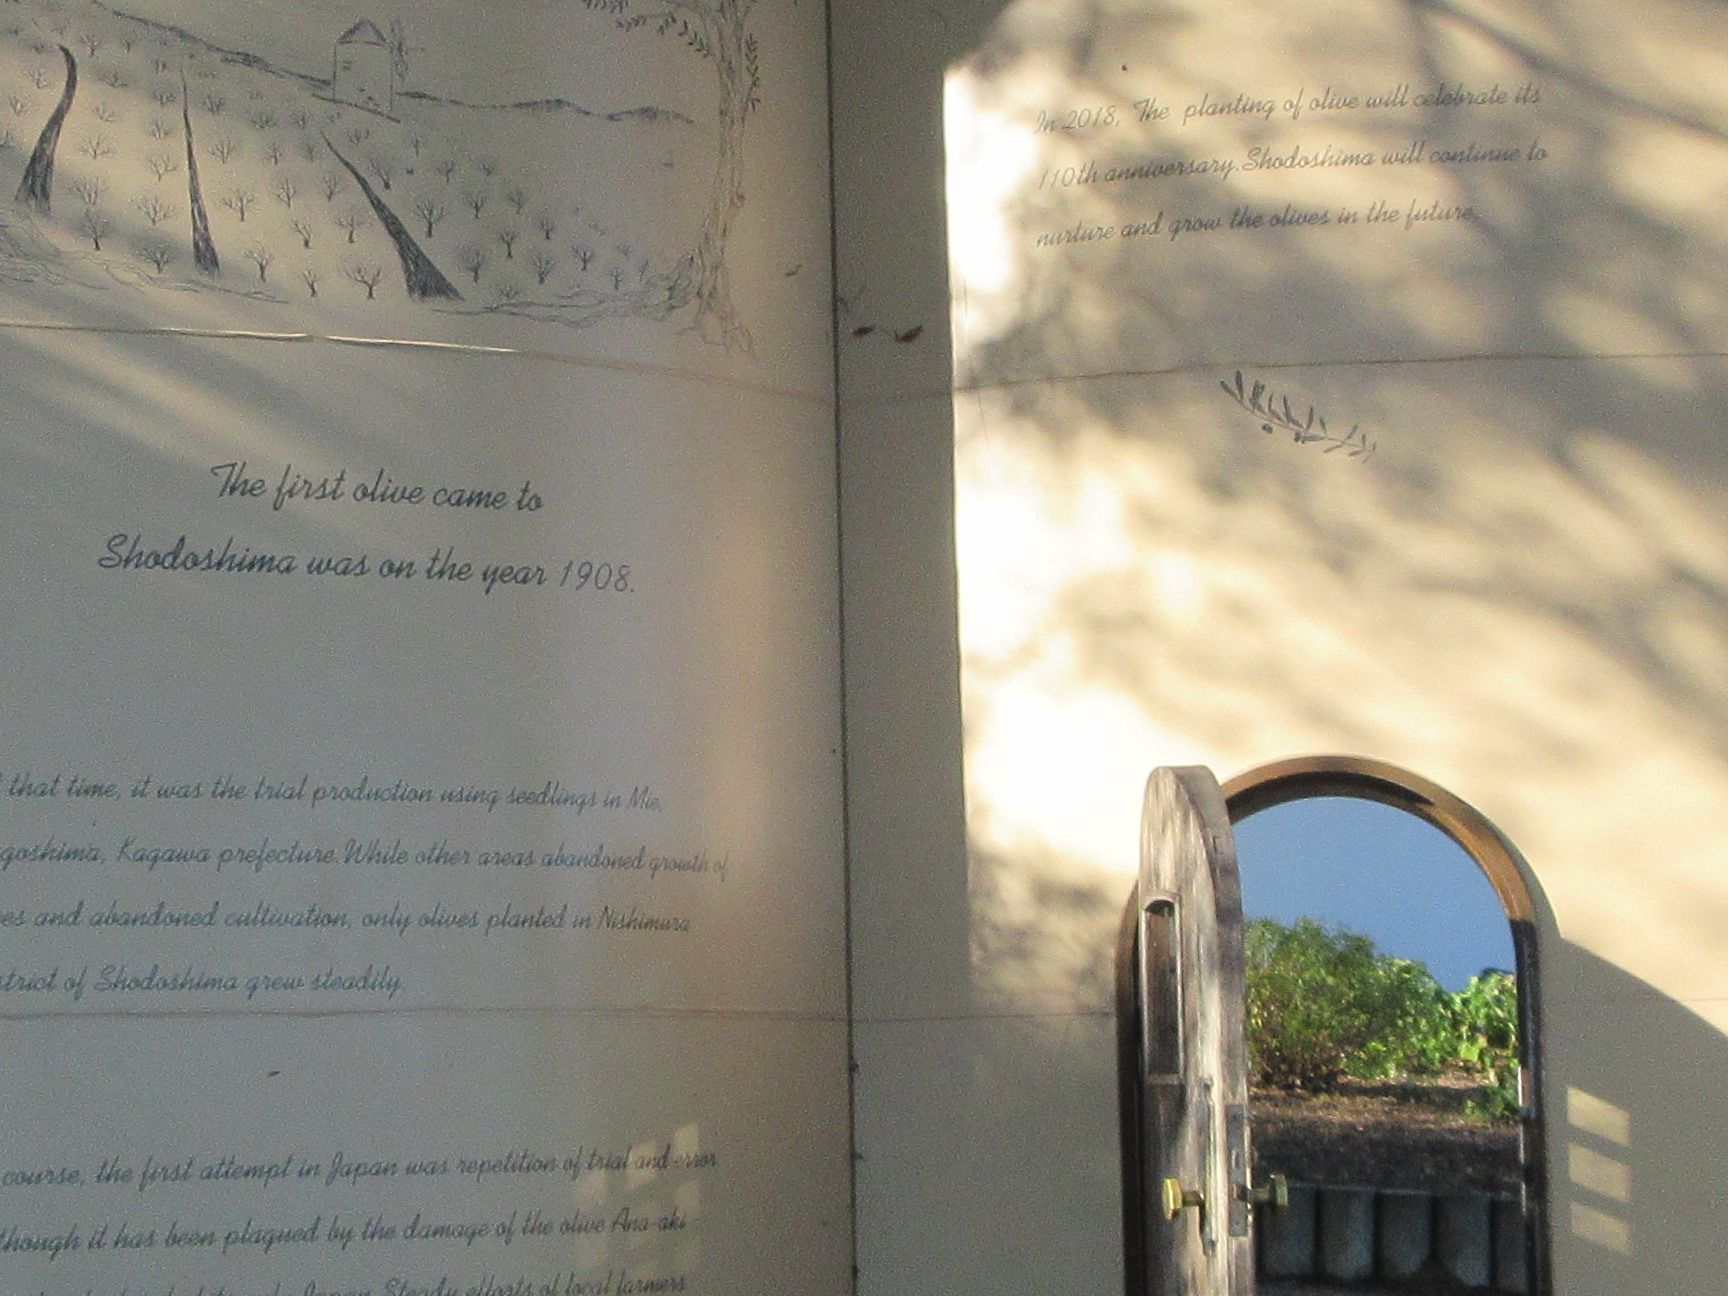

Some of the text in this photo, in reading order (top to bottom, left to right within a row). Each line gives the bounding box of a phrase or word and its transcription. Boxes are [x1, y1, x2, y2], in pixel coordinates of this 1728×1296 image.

[1034, 82, 1542, 135] In 2018, The planting of olive will celebrate its
[1038, 159, 1099, 190] 110th
[1242, 142, 1375, 172] Shodoshima
[1381, 140, 1425, 167] will
[1428, 142, 1521, 164] continue
[1525, 139, 1548, 163] to
[1036, 221, 1114, 247] nurture
[1120, 212, 1163, 237] and
[1168, 215, 1222, 241] grow
[1229, 205, 1263, 231] the
[1269, 203, 1329, 229] olives
[1336, 205, 1358, 225] in
[1365, 201, 1400, 224] the
[211, 461, 543, 512] The first olive came to
[98, 534, 635, 595] Shodoshima was on the year 1908.
[9, 773, 61, 798] that
[67, 774, 121, 801] time,
[130, 774, 151, 798] it
[157, 782, 202, 800] was
[210, 773, 246, 801] the
[254, 774, 308, 801] trial
[312, 775, 432, 809] production
[441, 785, 500, 813] using
[506, 780, 597, 816] seedlings
[603, 788, 622, 809] in
[117, 835, 212, 872] Kagawa
[344, 837, 408, 865] While
[414, 839, 470, 866] other
[478, 851, 534, 868] areas
[541, 842, 644, 871] abandoned
[649, 851, 709, 879] growth
[712, 849, 730, 882] of
[34, 901, 84, 927] and
[89, 900, 220, 928] abandoned
[362, 901, 411, 936] only
[418, 903, 477, 929] olives
[485, 903, 568, 936] planted
[573, 911, 593, 929] in
[596, 905, 690, 933] Nishimura
[64, 965, 88, 1002] of
[94, 963, 239, 992] Shodoshima
[246, 974, 305, 1001] grew
[95, 1155, 133, 1184] the
[139, 1155, 194, 1192] first
[199, 1154, 293, 1188] attempt
[297, 1158, 320, 1178] in
[325, 1151, 397, 1187] Japan
[405, 1159, 448, 1176] was
[456, 1149, 556, 1183] repetition
[562, 1146, 583, 1182] of
[588, 1144, 632, 1171] trial
[635, 1144, 671, 1169] and
[86, 1224, 108, 1251] it
[113, 1223, 157, 1249] has
[164, 1220, 216, 1248] been
[222, 1215, 322, 1254] plagued
[327, 1215, 354, 1250] by
[362, 1214, 396, 1241] the
[402, 1213, 489, 1247] damage
[494, 1209, 517, 1247] of
[522, 1207, 554, 1236] the
[560, 1208, 606, 1235] olive
[565, 1269, 612, 1296] local
